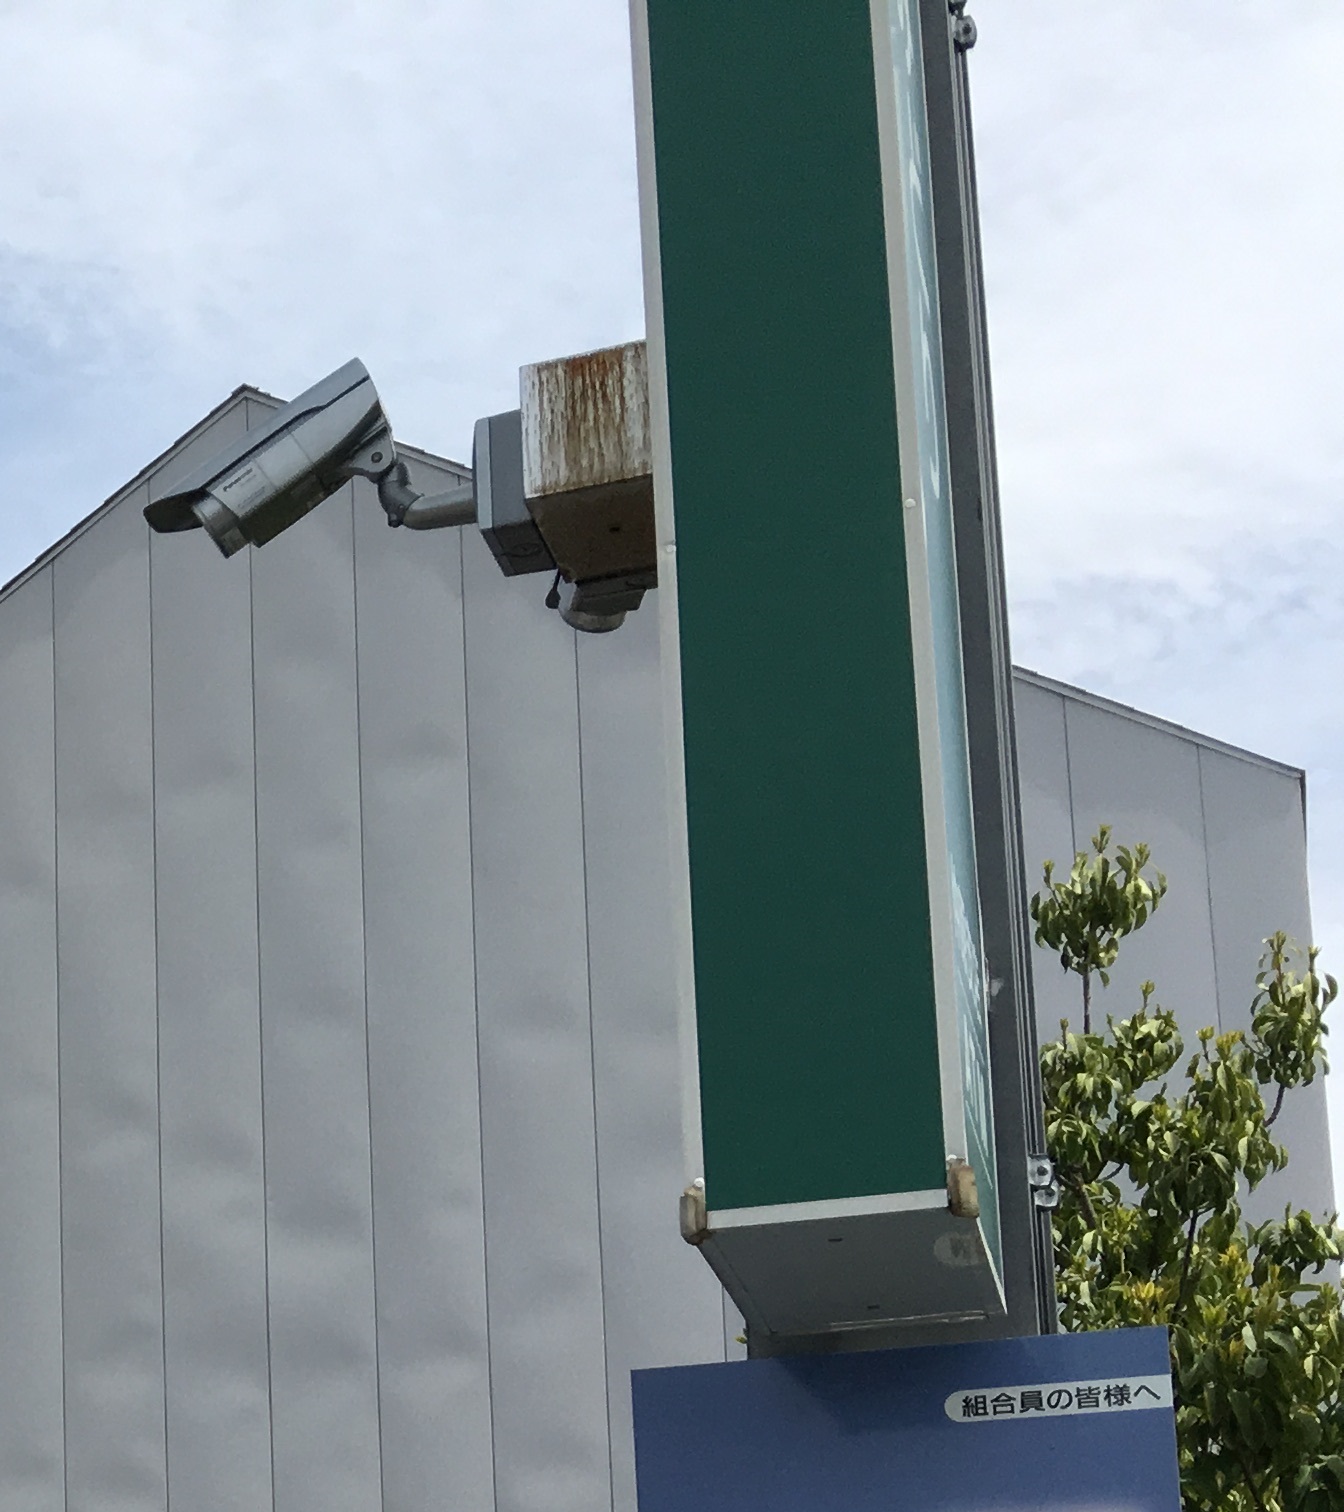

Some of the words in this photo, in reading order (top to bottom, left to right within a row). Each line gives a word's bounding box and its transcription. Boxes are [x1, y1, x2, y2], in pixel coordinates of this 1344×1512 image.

[962, 1383, 1161, 1418] 組合員の皆様へ
